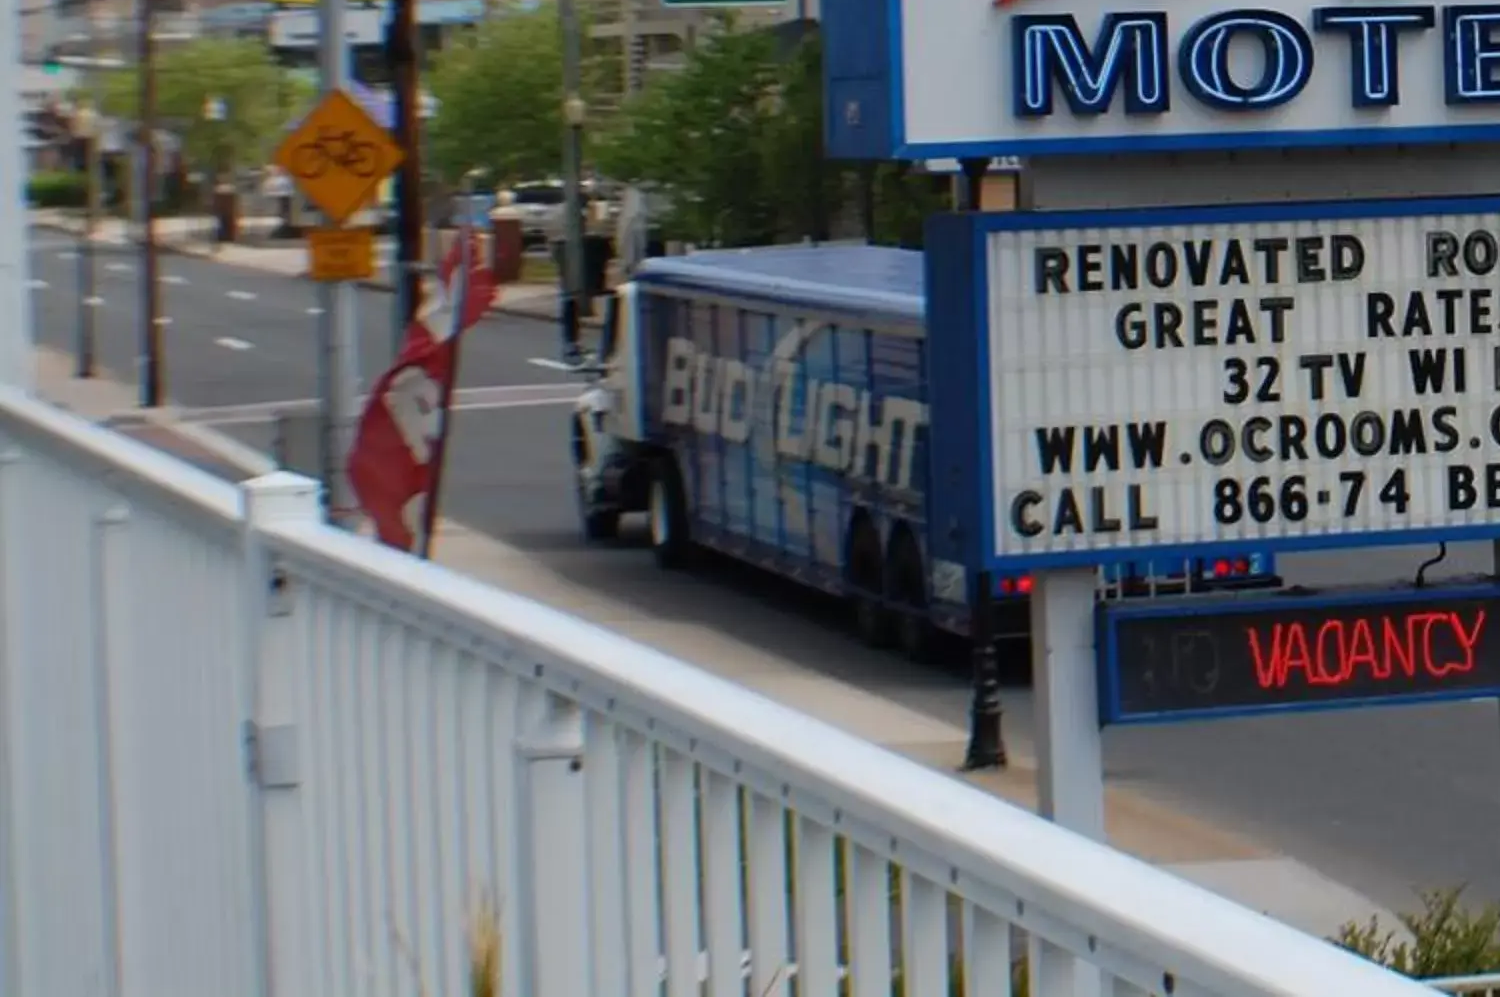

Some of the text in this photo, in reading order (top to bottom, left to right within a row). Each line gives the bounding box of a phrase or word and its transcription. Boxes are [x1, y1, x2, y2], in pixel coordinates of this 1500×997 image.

[1033, 234, 1366, 296] RENOVATED
[1115, 296, 1295, 351] GREAT
[1223, 355, 1282, 405] 32
[1299, 351, 1367, 401] TV
[1408, 346, 1467, 395] WI
[661, 335, 929, 491] BUD LIGHT
[1010, 483, 1159, 539] CALL
[1247, 609, 1486, 689] VACANCY
